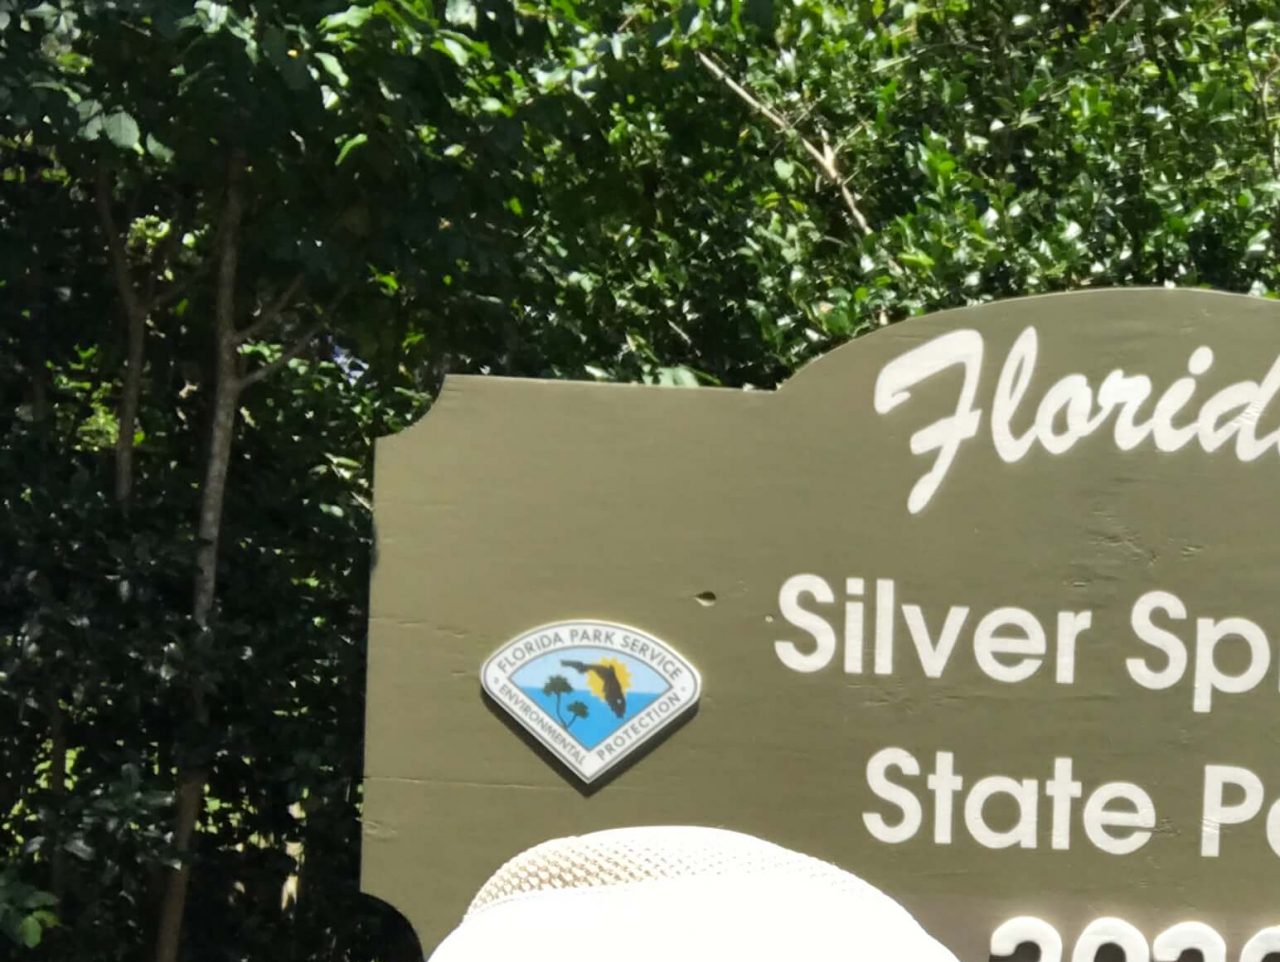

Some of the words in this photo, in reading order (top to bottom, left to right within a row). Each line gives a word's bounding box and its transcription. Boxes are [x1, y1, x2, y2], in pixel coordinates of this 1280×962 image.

[497, 632, 565, 674] FLORIDA
[569, 628, 616, 644] PARK
[620, 634, 683, 681] SERVICE
[774, 574, 1092, 685] Silver
[499, 683, 587, 766] ENVIRONMENTAL
[596, 692, 681, 761] PROTECTION
[862, 747, 1157, 856] State
